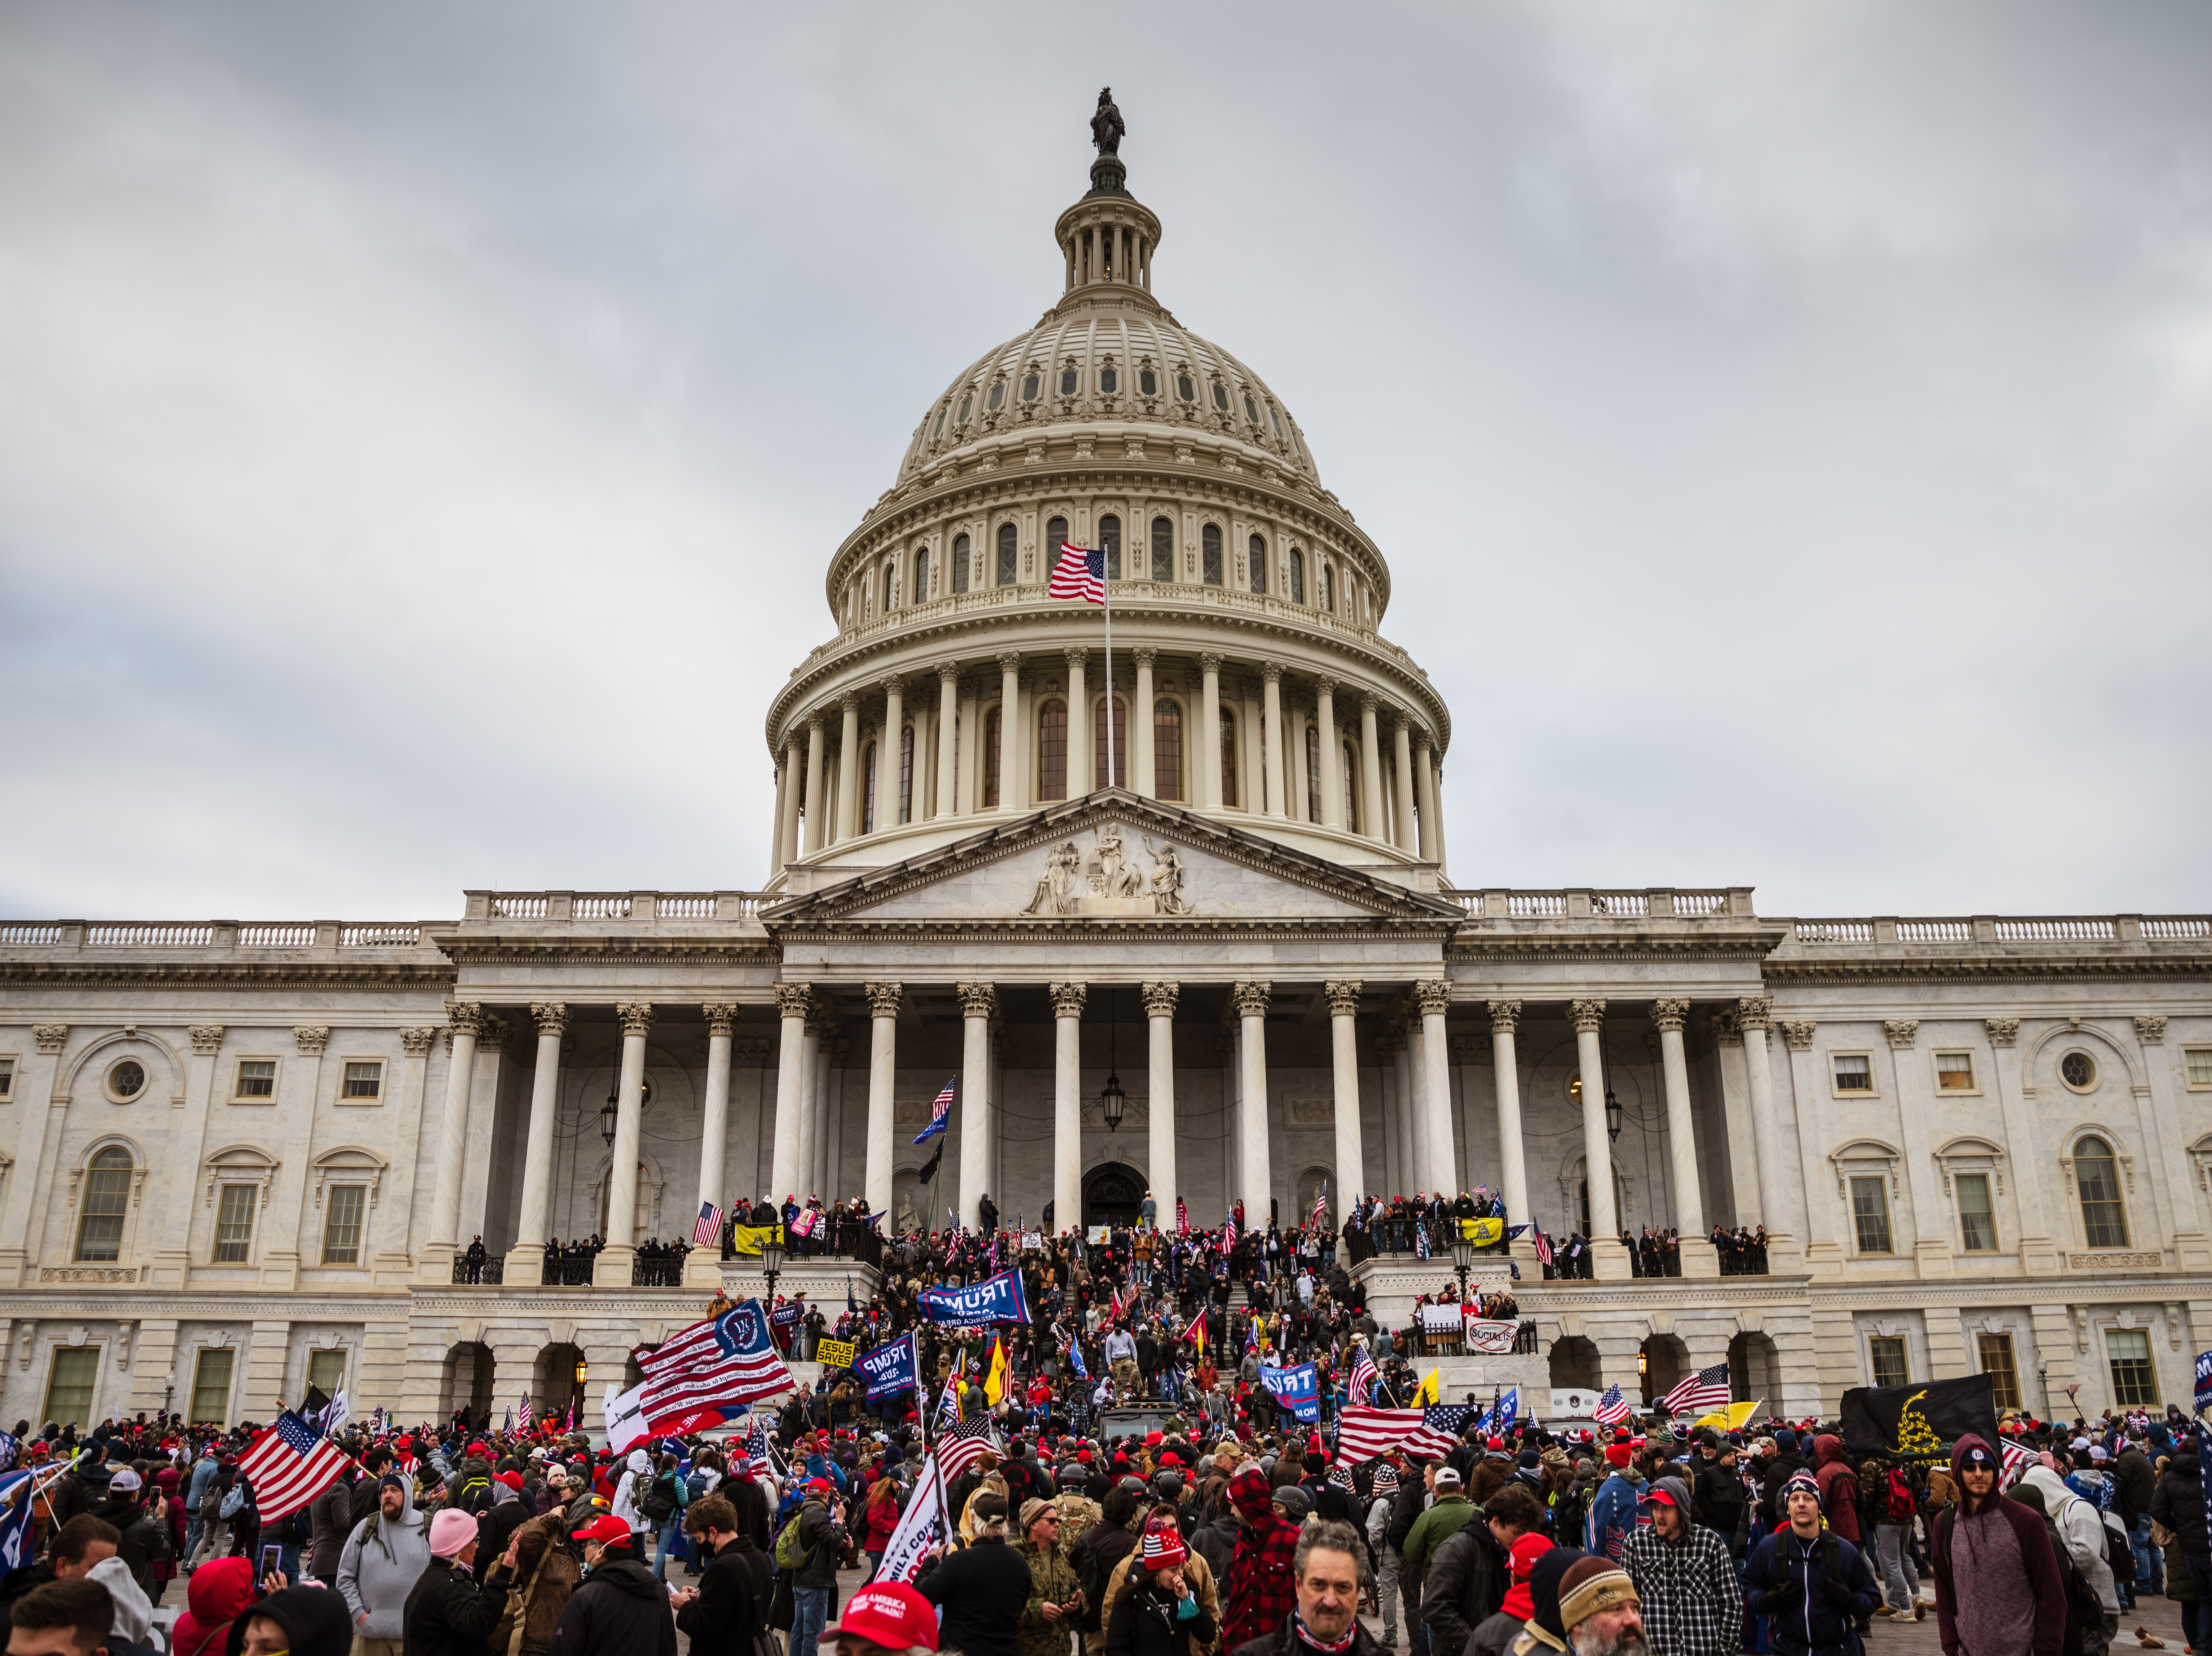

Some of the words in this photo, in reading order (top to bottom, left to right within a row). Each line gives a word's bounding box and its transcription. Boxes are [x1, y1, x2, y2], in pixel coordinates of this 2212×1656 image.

[1472, 1328, 1514, 1342] SOCIALIS
[820, 1341, 852, 1355] JESUS
[818, 1351, 851, 1365] SAVES
[942, 1409, 956, 1419] President
[889, 1549, 910, 1582] MILY
[867, 1593, 907, 1611] AMERICA
[1589, 1590, 1623, 1607] GUINNESS
[873, 1603, 904, 1619] AGAIN!
